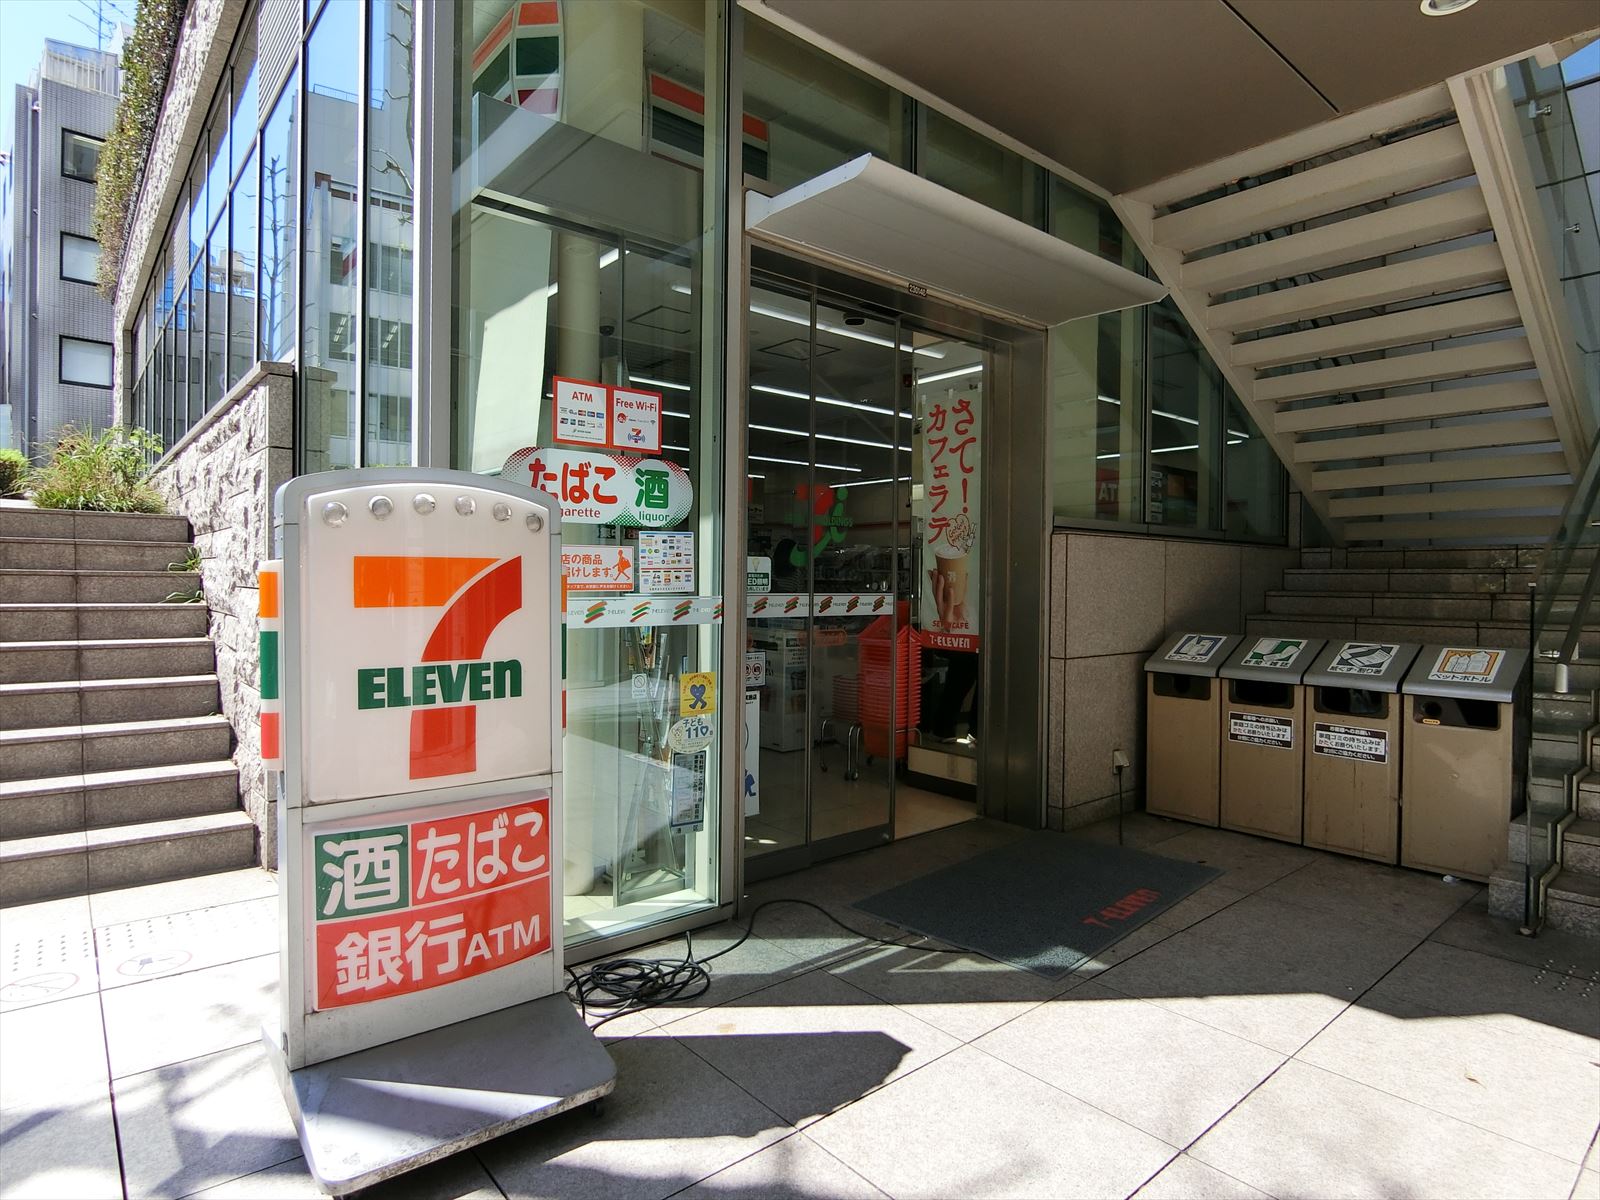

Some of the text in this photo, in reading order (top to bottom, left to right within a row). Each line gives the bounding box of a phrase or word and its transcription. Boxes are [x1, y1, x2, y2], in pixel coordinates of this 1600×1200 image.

[571, 391, 593, 403] ATM
[615, 397, 657, 413] Free Wi-Fi
[528, 457, 618, 504] たばこ
[926, 404, 950, 544] カフェラテ
[635, 467, 670, 509] 酒
[1099, 482, 1119, 502] AT
[638, 510, 670, 523] liquor
[1431, 673, 1492, 682] ペットボトル
[683, 717, 704, 728] 子ども
[415, 812, 546, 895] たばこ
[322, 833, 404, 917] 酒
